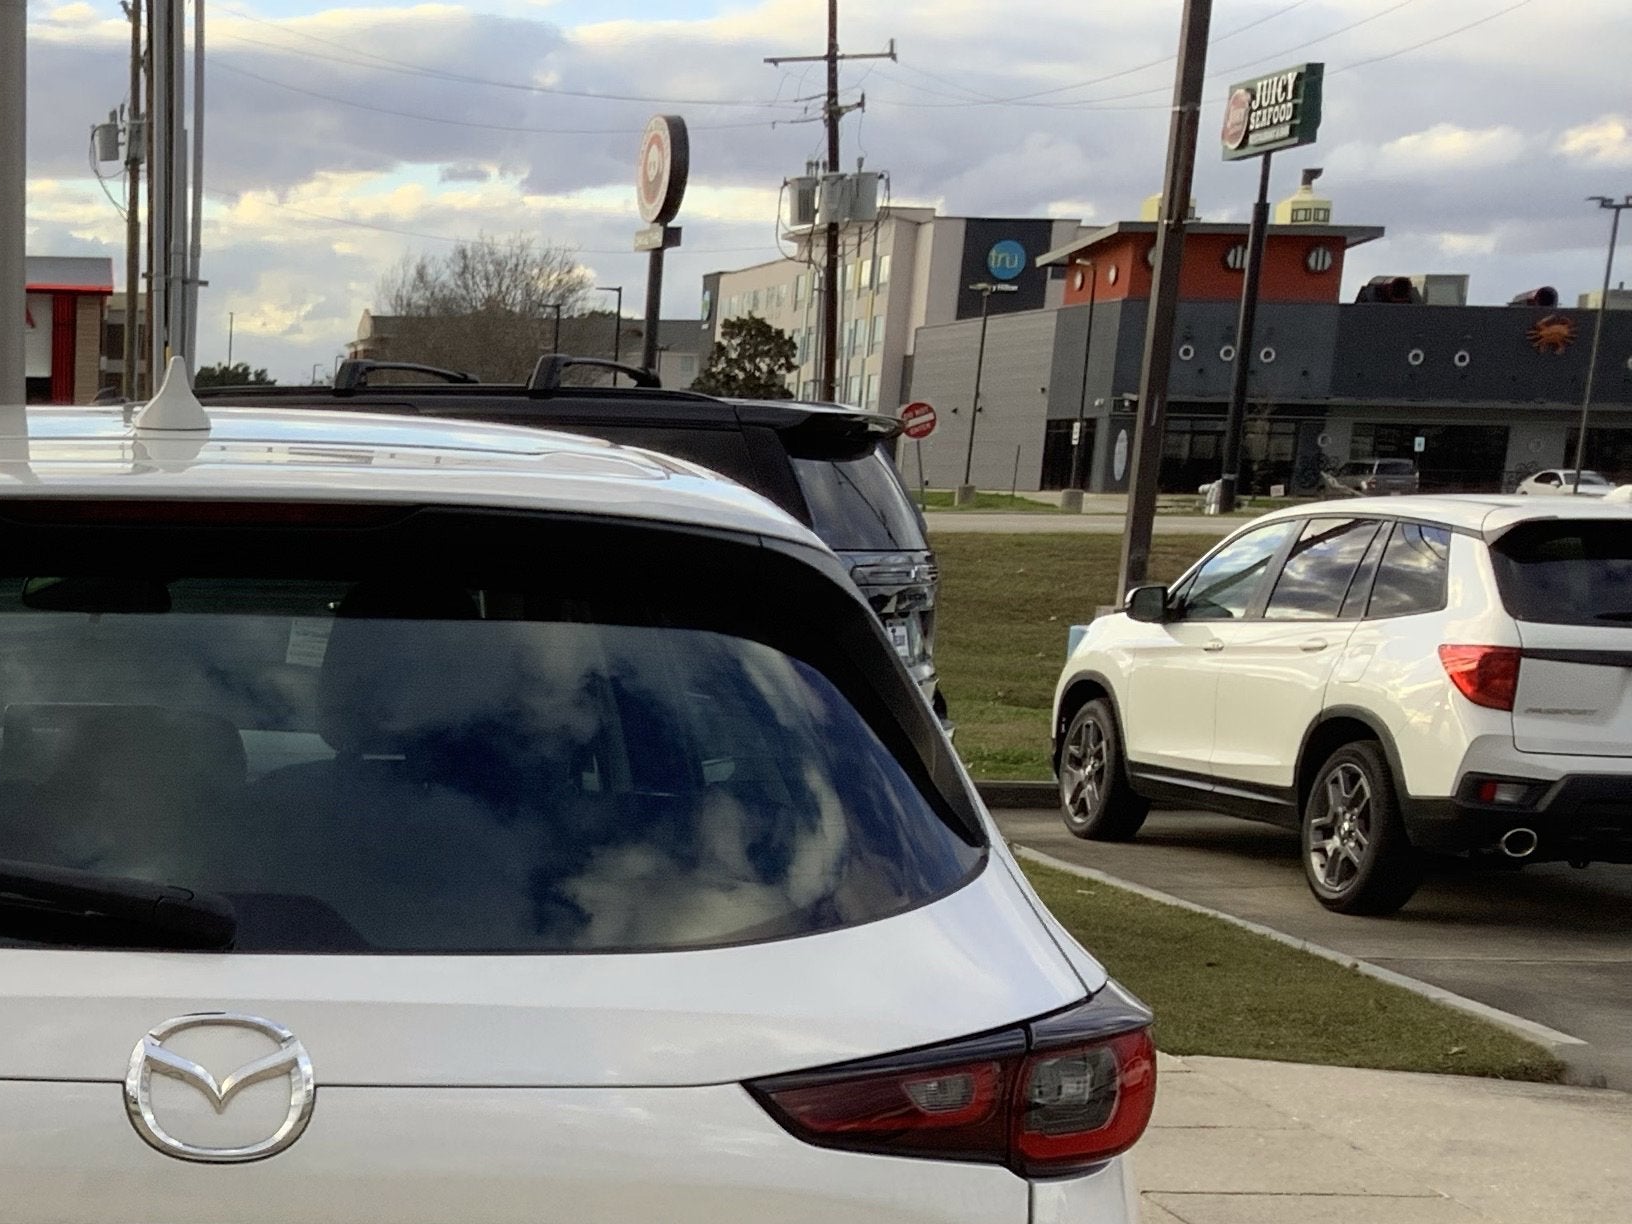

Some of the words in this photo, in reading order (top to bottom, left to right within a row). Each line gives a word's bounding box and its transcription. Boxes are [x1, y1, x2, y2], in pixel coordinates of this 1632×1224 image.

[1251, 71, 1298, 110] JUICY
[1249, 101, 1294, 131] SEAFOOD
[988, 248, 1019, 269] tru
